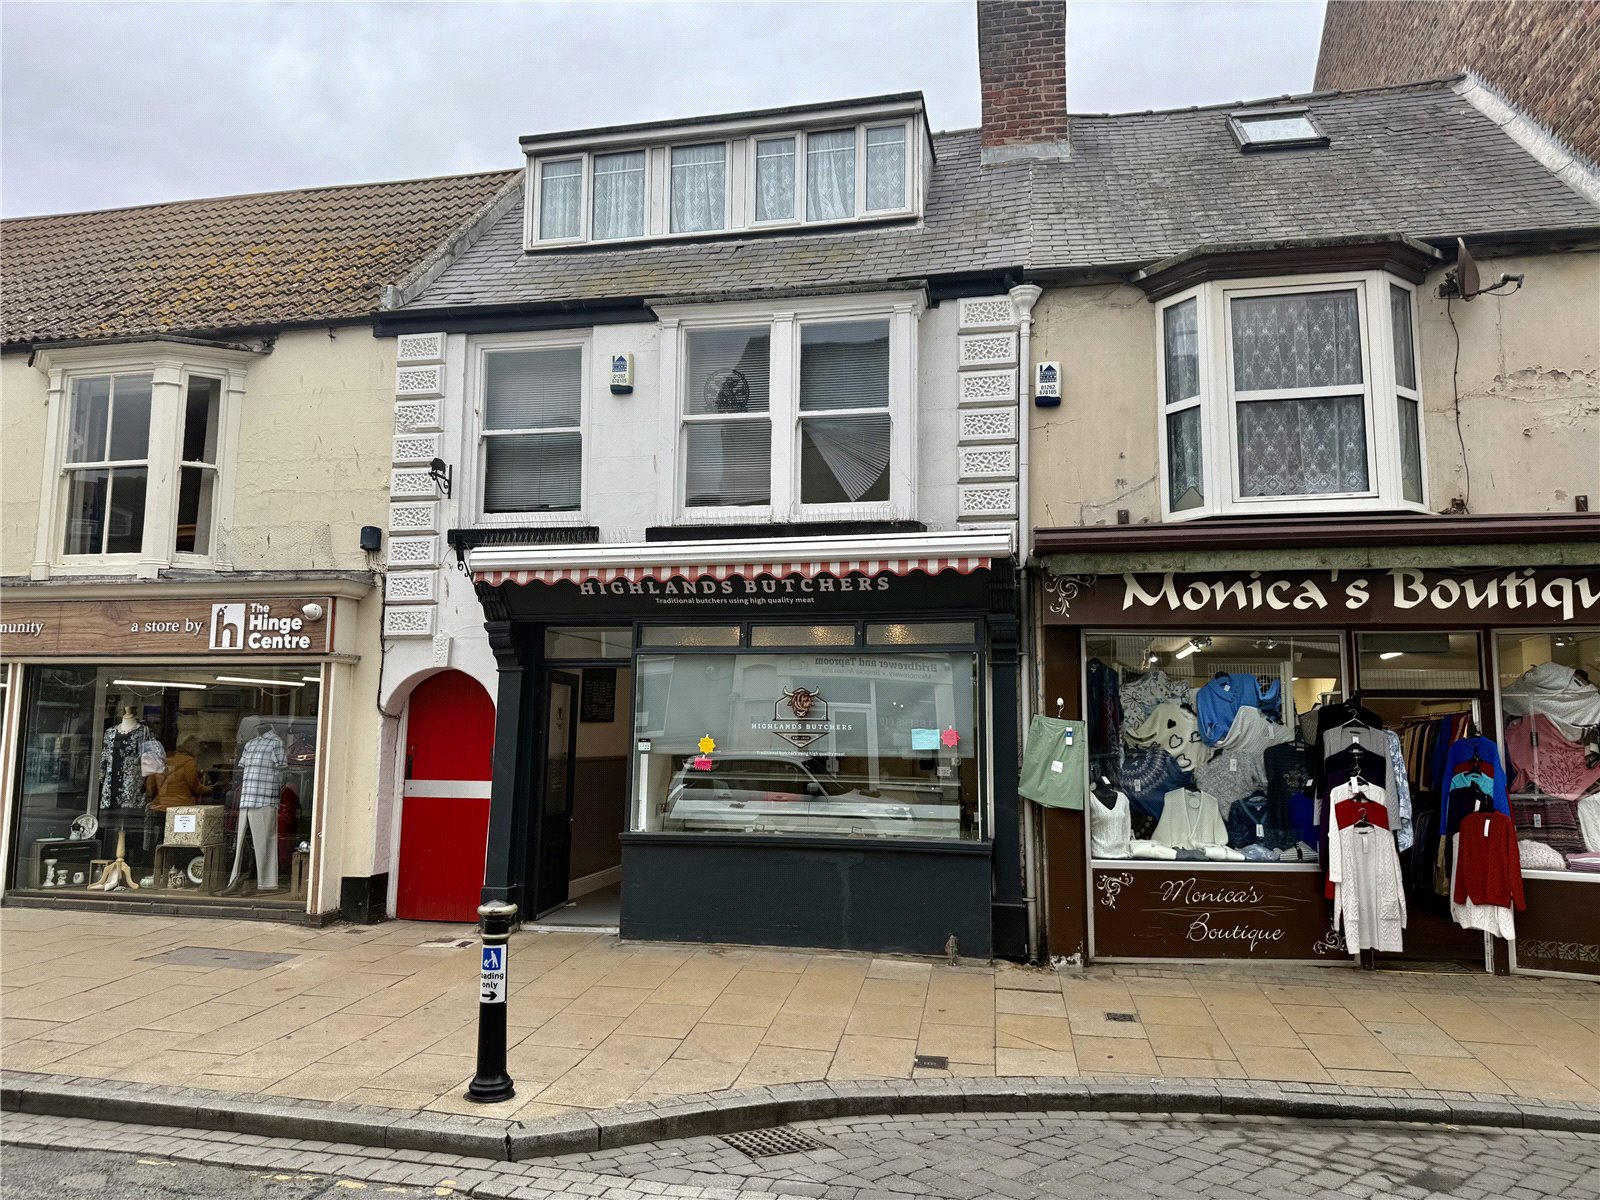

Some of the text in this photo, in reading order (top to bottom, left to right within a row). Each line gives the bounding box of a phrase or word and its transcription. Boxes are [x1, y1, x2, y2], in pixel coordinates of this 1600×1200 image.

[580, 577, 890, 594] HIGHLANDS BUTCHERS
[1122, 569, 1370, 610] Monica's
[250, 602, 270, 612] The
[131, 622, 138, 632] a
[144, 620, 179, 632] store
[185, 618, 202, 636] by
[249, 614, 302, 634] Hinge
[248, 632, 310, 649] Centre
[1160, 877, 1264, 904] Monica's
[1186, 912, 1286, 952] Boutique
[482, 981, 498, 990] only
